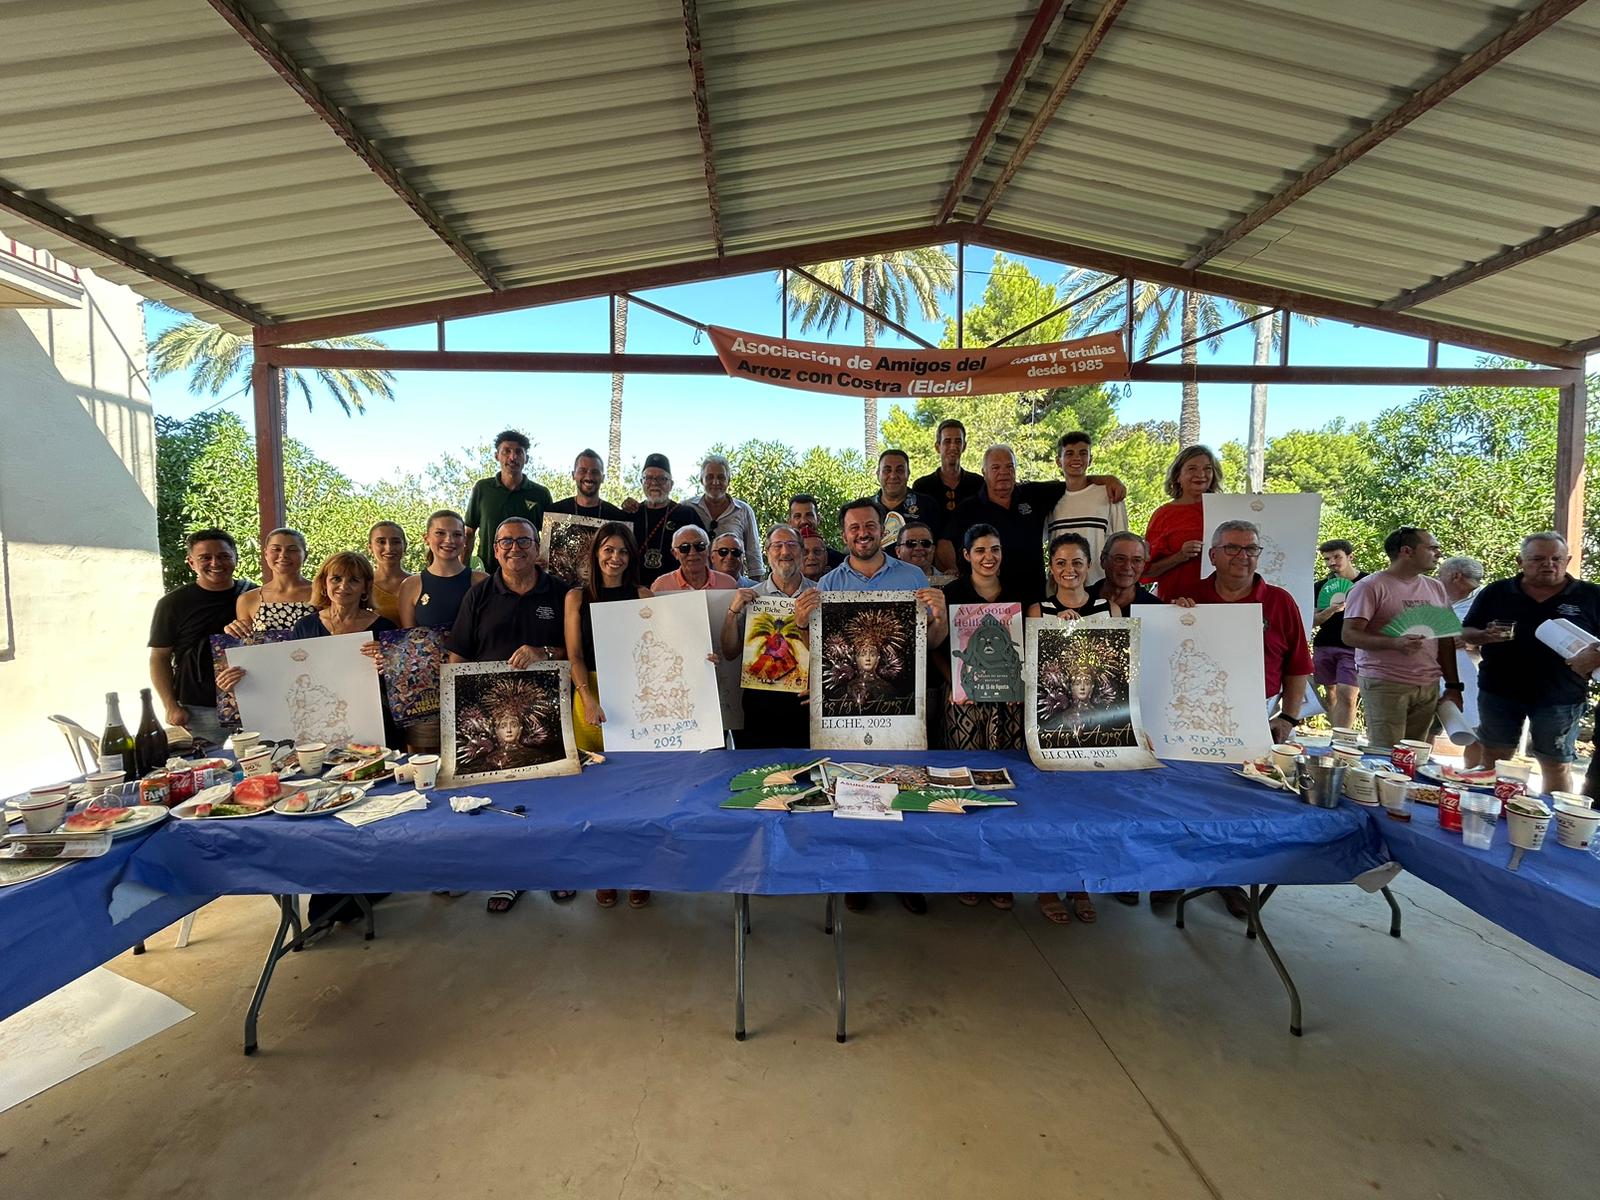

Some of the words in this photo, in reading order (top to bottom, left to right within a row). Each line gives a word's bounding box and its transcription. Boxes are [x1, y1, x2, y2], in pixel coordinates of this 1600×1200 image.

[731, 337, 841, 367] Asociación
[846, 355, 872, 370] de
[875, 356, 951, 376] Amigos
[956, 356, 987, 372] del
[1049, 352, 1058, 363] y
[1060, 345, 1116, 360] Tertulias
[1027, 363, 1067, 378] desde
[1070, 359, 1104, 373] 1985
[737, 359, 792, 380] Arroz
[796, 370, 833, 385] con
[837, 372, 902, 393] Costra
[907, 377, 973, 396] (Elche)
[821, 718, 865, 730] ELCHE,
[867, 718, 892, 729] 2023
[654, 736, 682, 749] 2023
[1090, 748, 1118, 759] 2023
[1191, 746, 1227, 760] 2023
